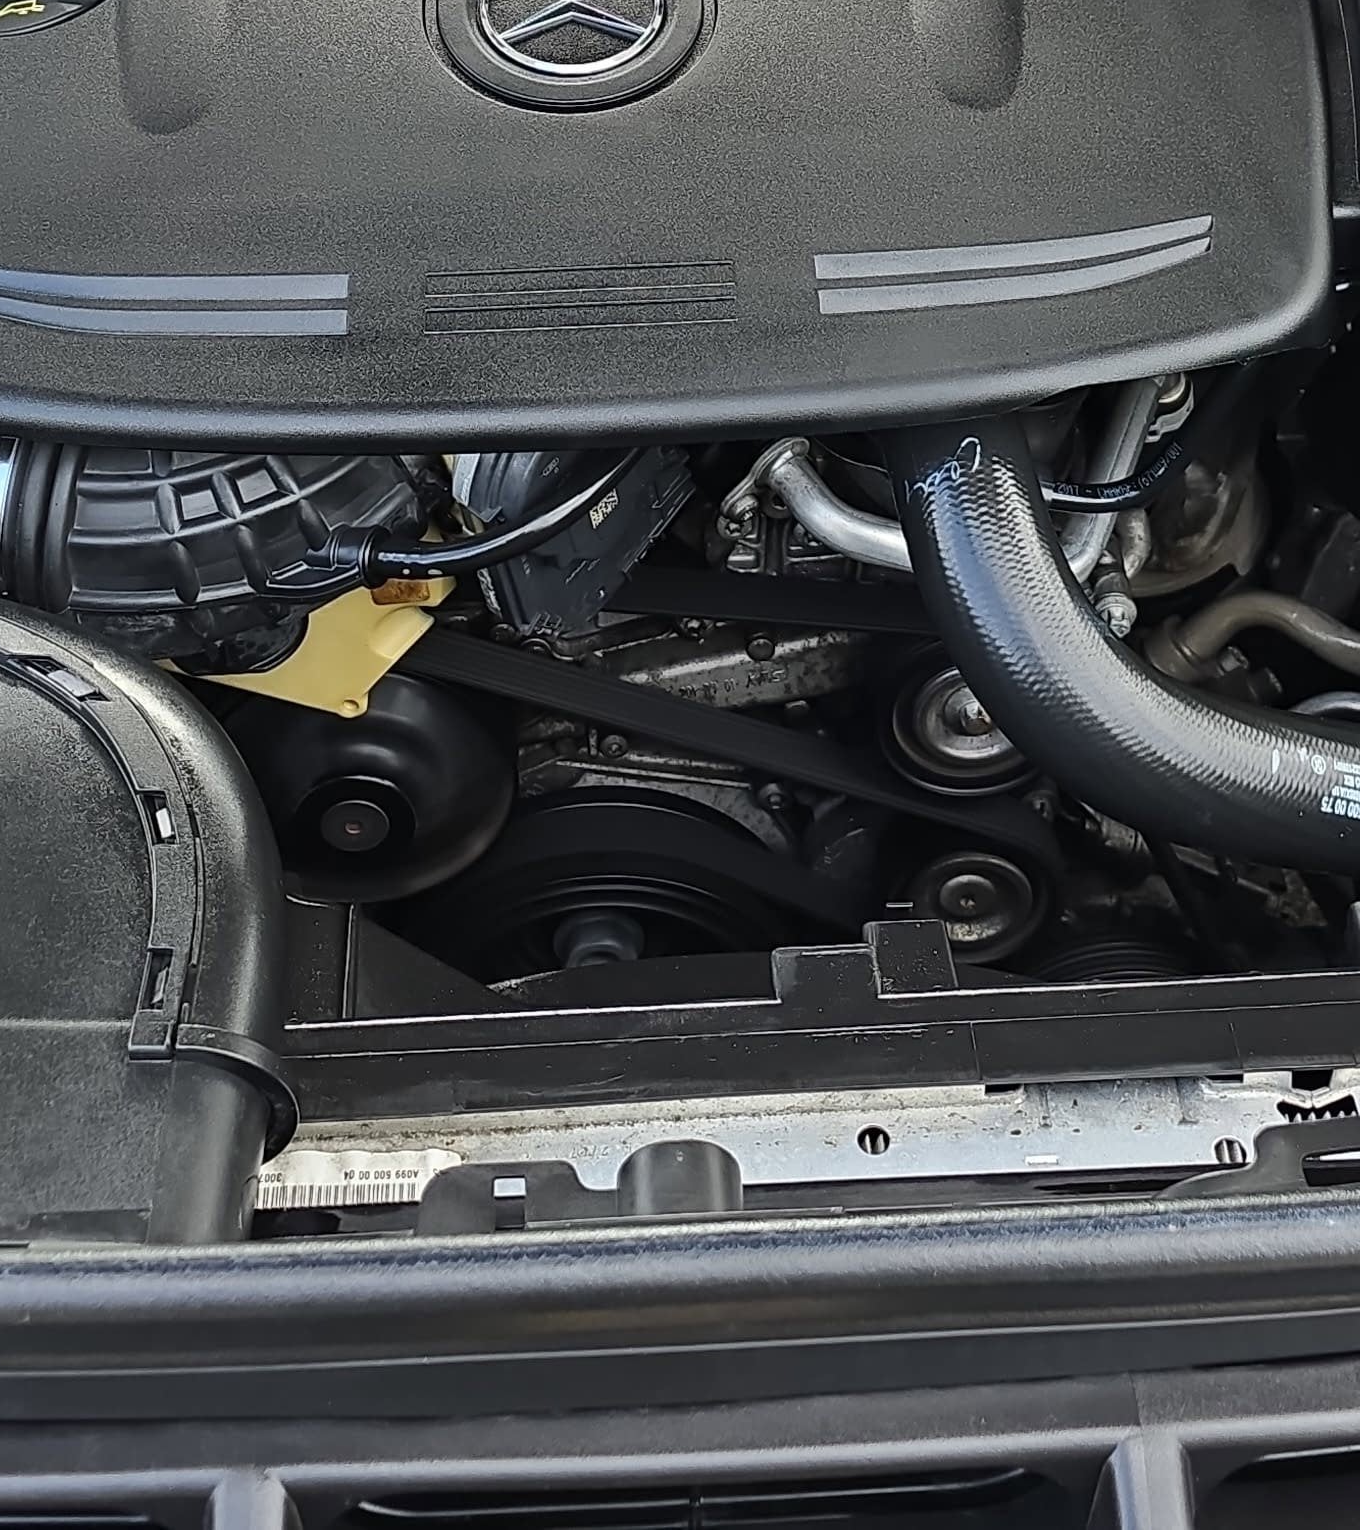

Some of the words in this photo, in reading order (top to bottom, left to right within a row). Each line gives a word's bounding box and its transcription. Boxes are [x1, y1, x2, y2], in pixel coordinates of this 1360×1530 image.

[1320, 796, 1334, 813] 75
[1334, 798, 1347, 815] 00
[358, 1170, 371, 1180] 00
[374, 1170, 390, 1180] 500
[391, 1170, 419, 1180] A099
